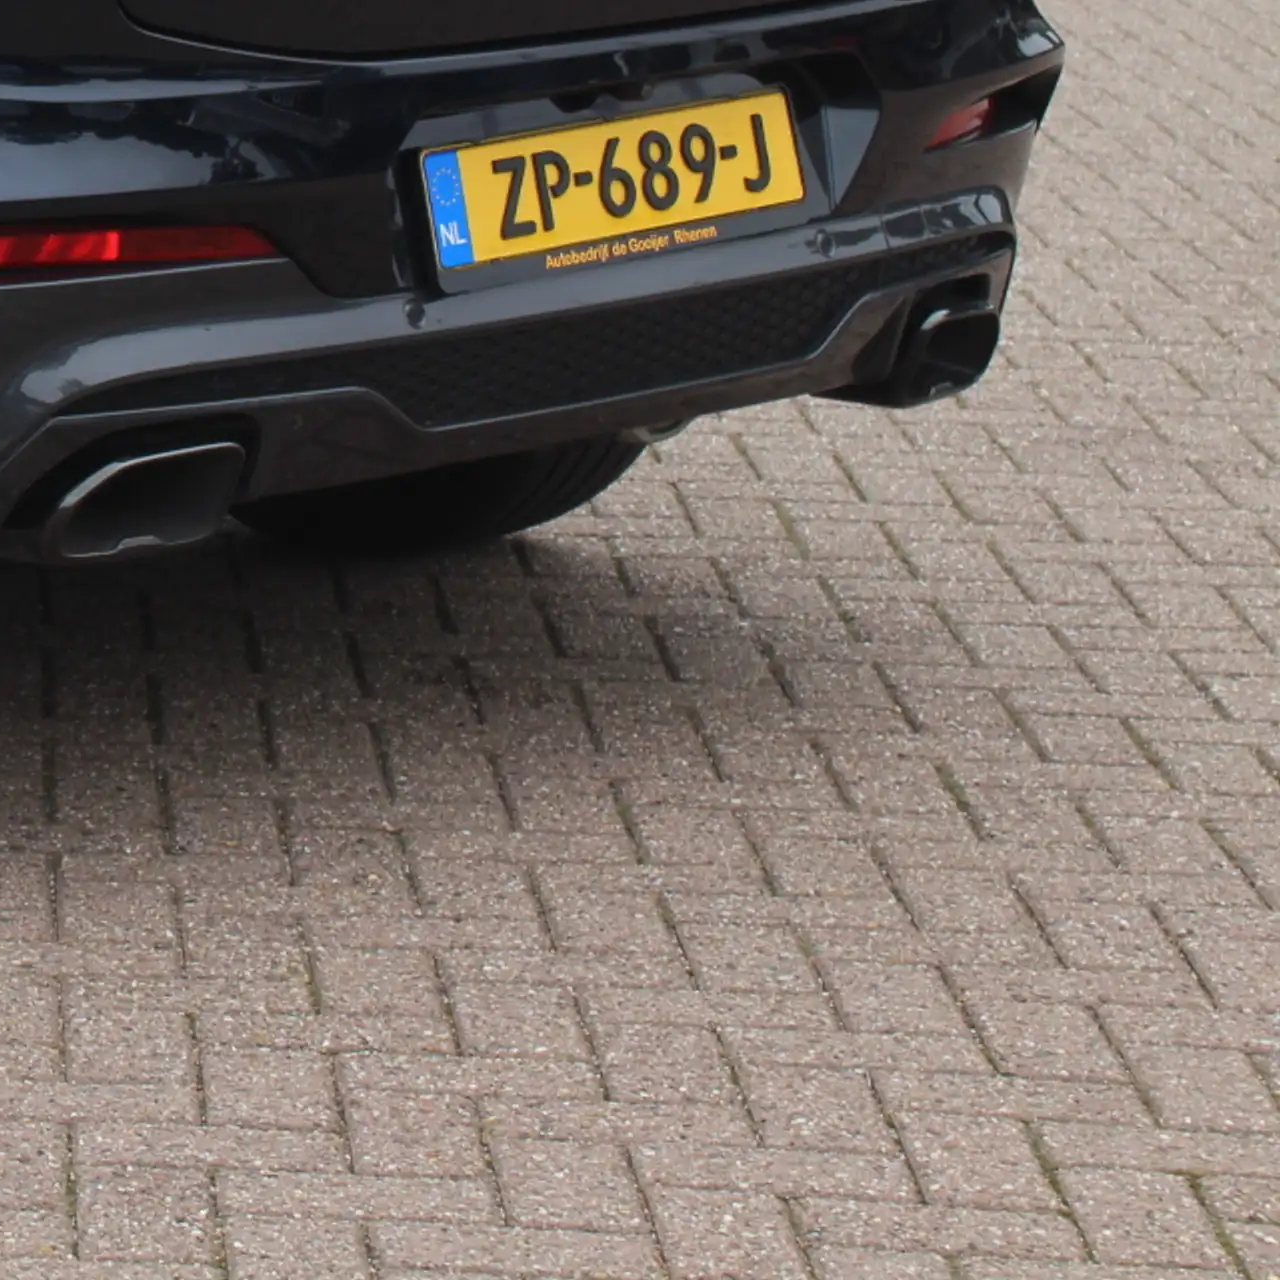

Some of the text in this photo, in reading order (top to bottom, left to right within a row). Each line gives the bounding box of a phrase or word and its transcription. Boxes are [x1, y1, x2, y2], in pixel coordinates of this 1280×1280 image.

[491, 112, 773, 241] ZP-689-J
[440, 220, 468, 247] NL
[612, 241, 628, 257] de
[673, 224, 718, 244] Rhenen
